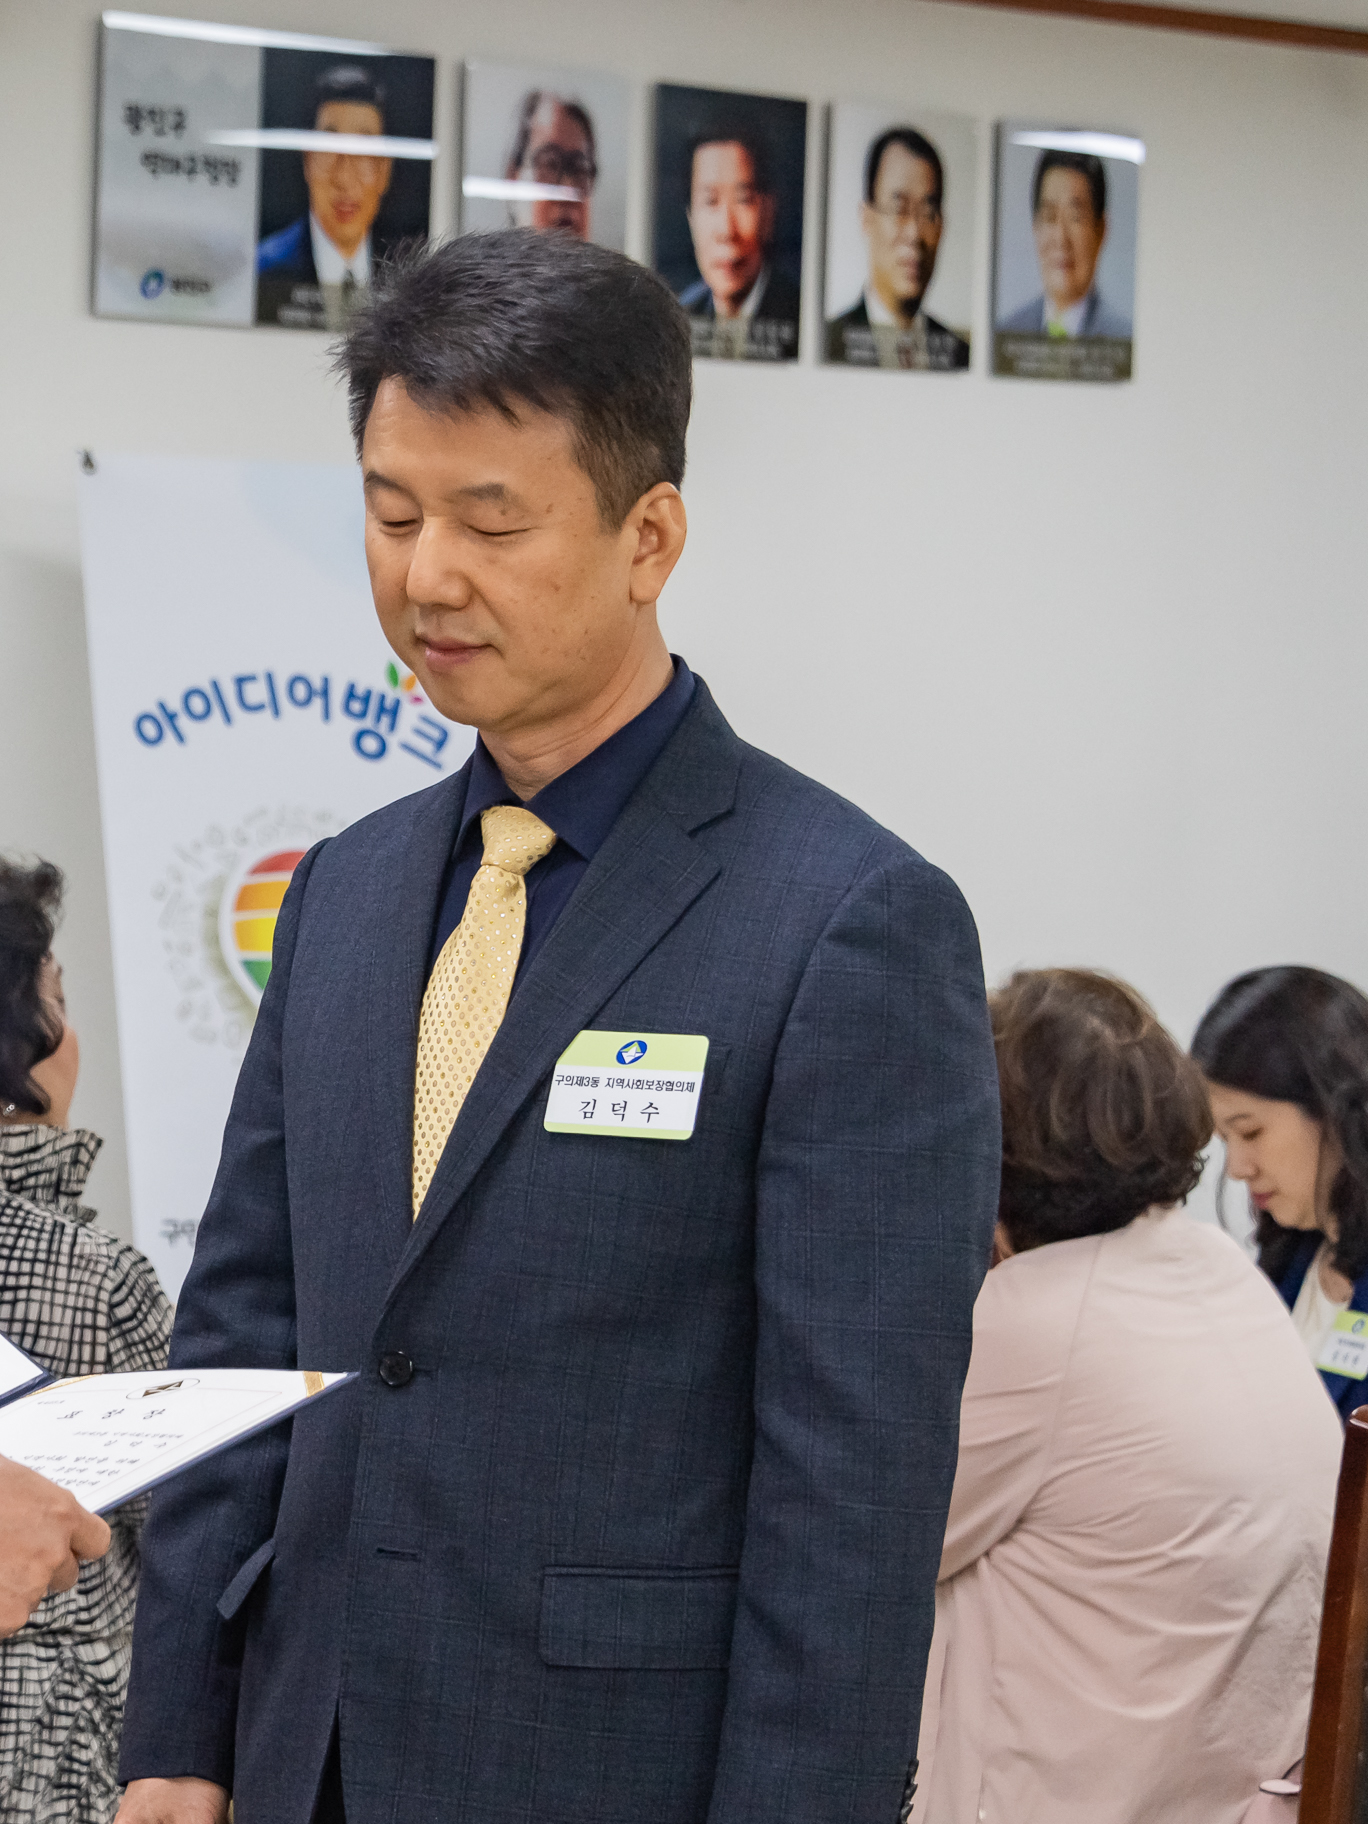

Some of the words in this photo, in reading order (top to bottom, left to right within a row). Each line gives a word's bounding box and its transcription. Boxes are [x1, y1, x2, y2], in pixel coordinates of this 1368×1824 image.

[133, 670, 450, 770] 아이디어뱅크
[554, 1074, 600, 1088] 구의제3동
[604, 1077, 696, 1093] 지역사회보장협의체
